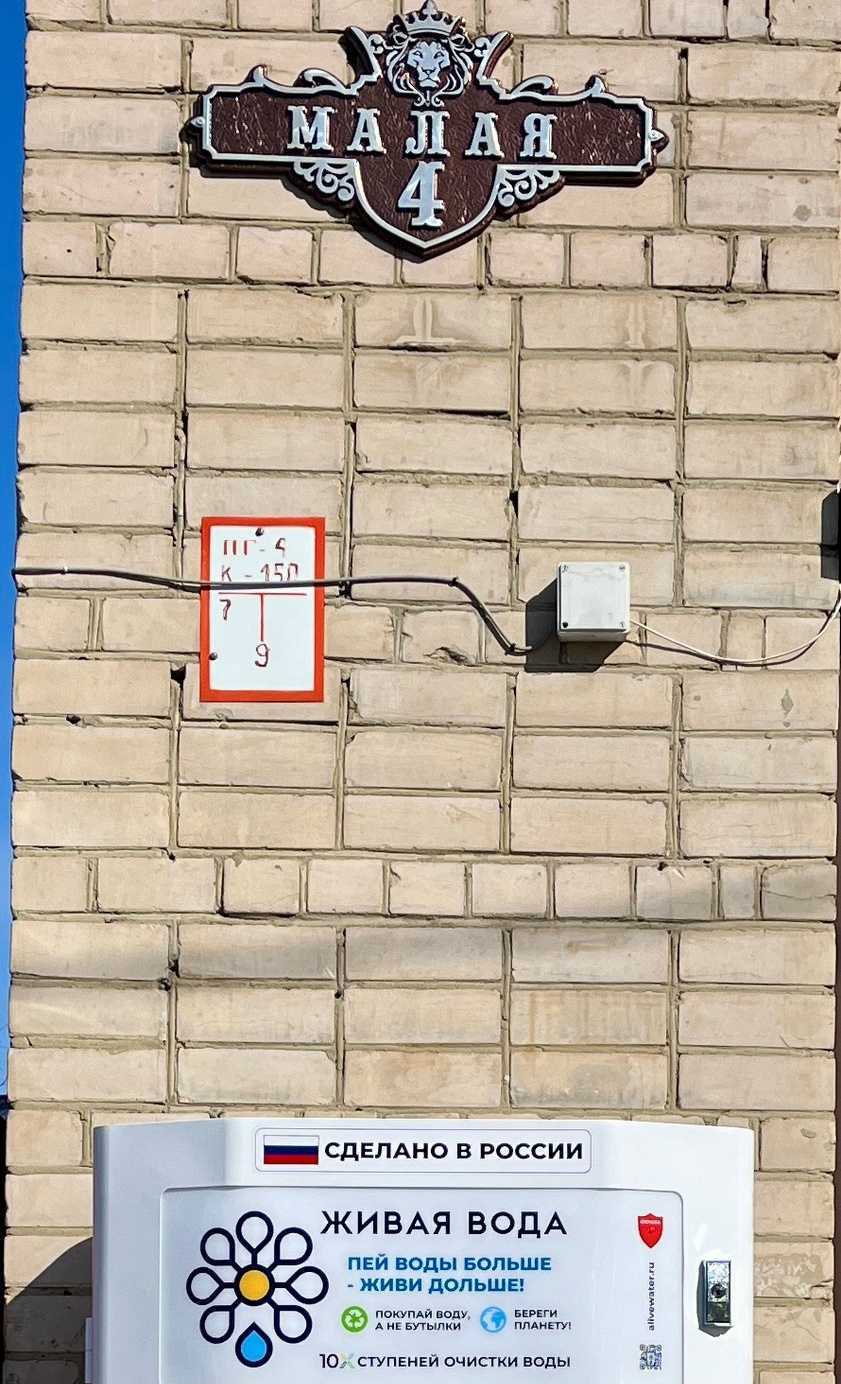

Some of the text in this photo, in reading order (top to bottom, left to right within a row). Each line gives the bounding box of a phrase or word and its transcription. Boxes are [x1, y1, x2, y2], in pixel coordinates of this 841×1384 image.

[287, 105, 557, 160] МАЛАЯ
[398, 161, 445, 227] 4
[219, 598, 231, 621] 7
[255, 643, 269, 667] 9
[324, 1141, 583, 1161] СДЕЛАНО В РОССИИ
[320, 1210, 567, 1239] ЖИВАЯ ВОДА
[347, 1253, 552, 1273] ПЕЙ ВОДЫ БОЛЬШЕ
[360, 1278, 422, 1292] ЖИВИ
[428, 1278, 525, 1294] ДОЛЬШЕ!
[375, 1309, 471, 1321] ПОКУПАЙ ВОДУ,
[514, 1309, 557, 1318] БЕРЕГИ
[375, 1322, 461, 1331] А НЕ БУТЫЛКИ
[514, 1321, 572, 1331] ПЛАНЕТУ!
[357, 1354, 439, 1368] СТУПЕНЕЙ
[444, 1356, 519, 1368] ОЧИСТКИ
[523, 1356, 571, 1369] ВОДЫ
